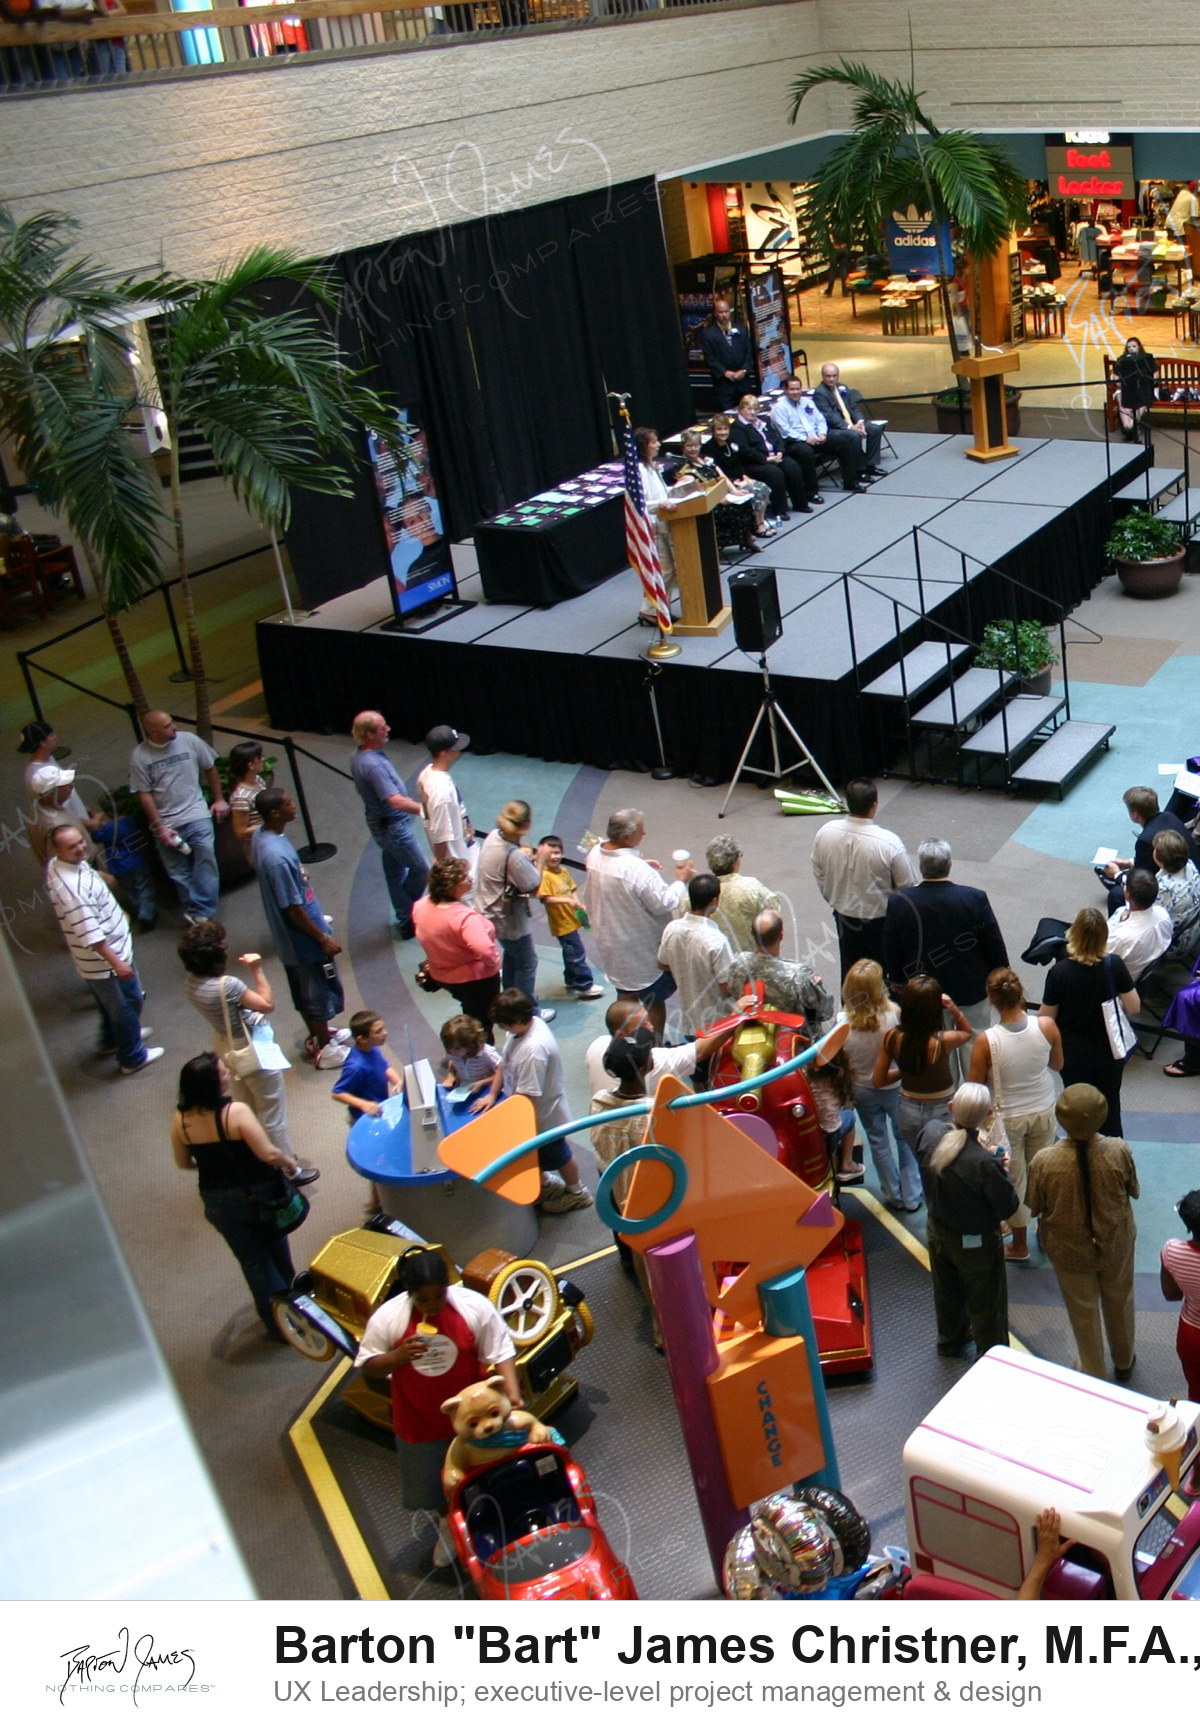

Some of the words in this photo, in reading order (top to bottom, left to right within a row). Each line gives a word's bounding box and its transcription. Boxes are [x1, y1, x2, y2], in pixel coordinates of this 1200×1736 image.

[1066, 148, 1112, 169] Foot
[1057, 176, 1124, 196] Locker
[894, 235, 937, 247] adidas
[756, 1380, 783, 1468] CHANGE
